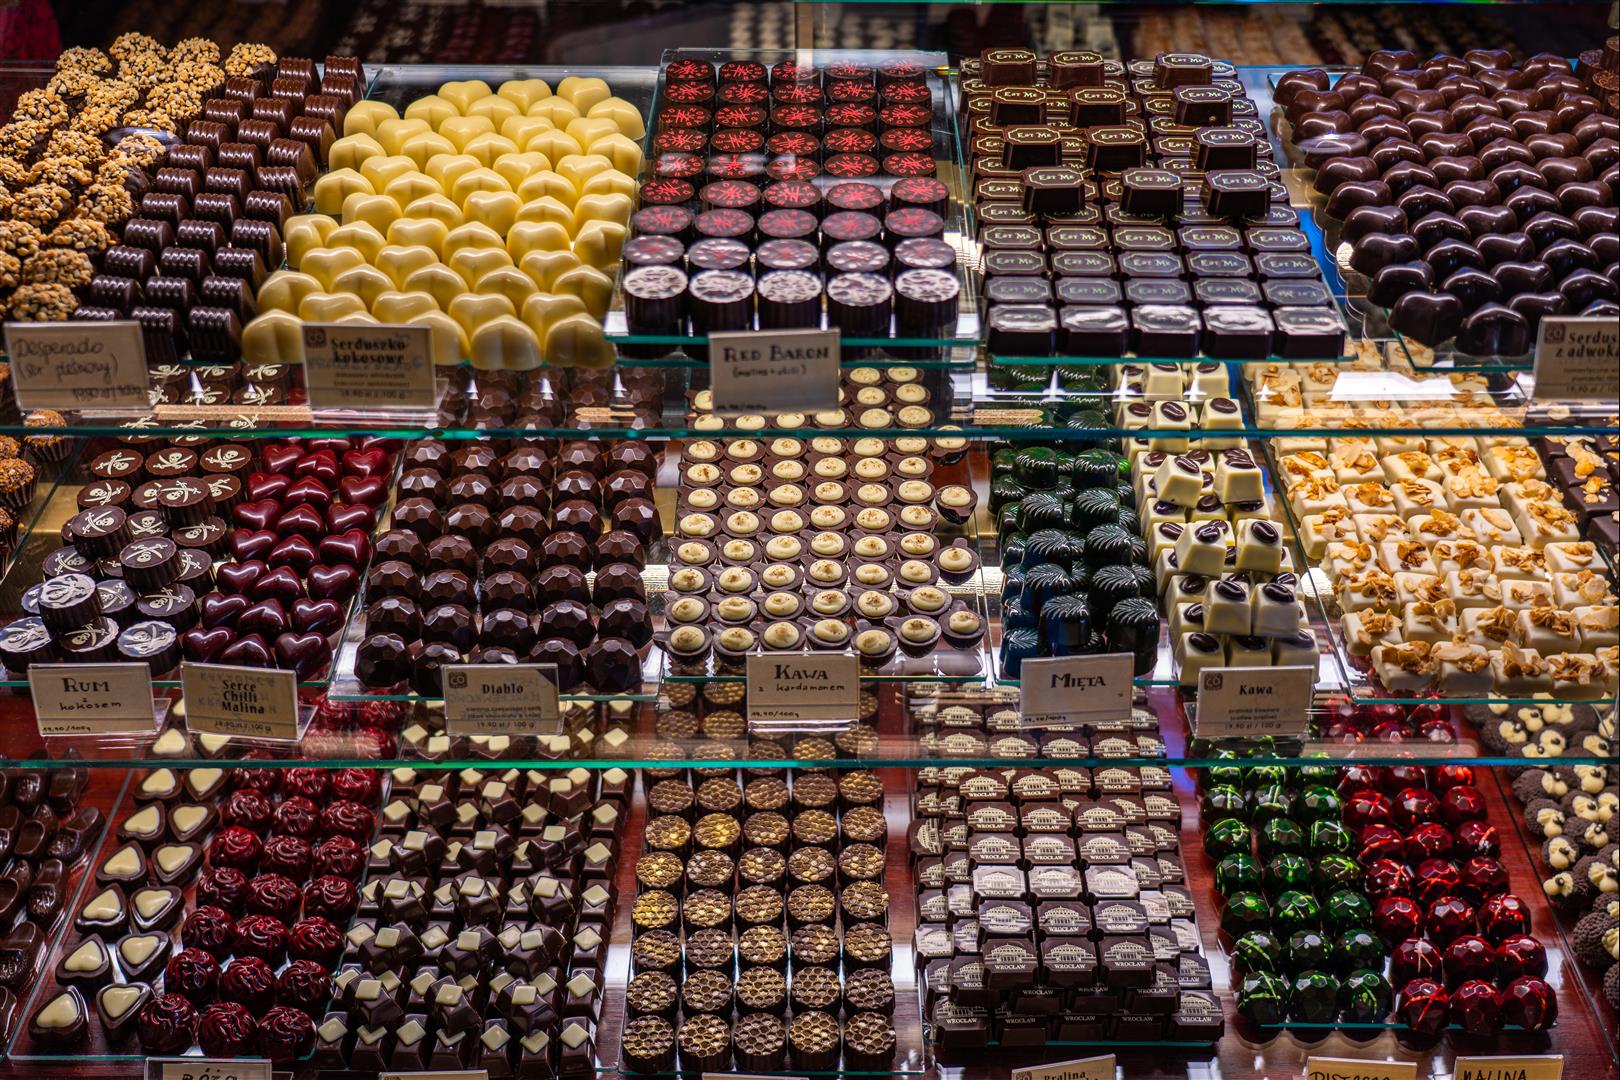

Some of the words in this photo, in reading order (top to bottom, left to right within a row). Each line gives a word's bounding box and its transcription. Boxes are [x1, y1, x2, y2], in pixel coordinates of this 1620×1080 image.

[1569, 330, 1617, 344] Serdus
[222, 680, 256, 692] Serce
[482, 683, 524, 694] Diablo
[1239, 684, 1273, 695] Kawa
[223, 690, 258, 703] Chilli
[60, 701, 122, 711] kokosem
[222, 702, 265, 714] Malina
